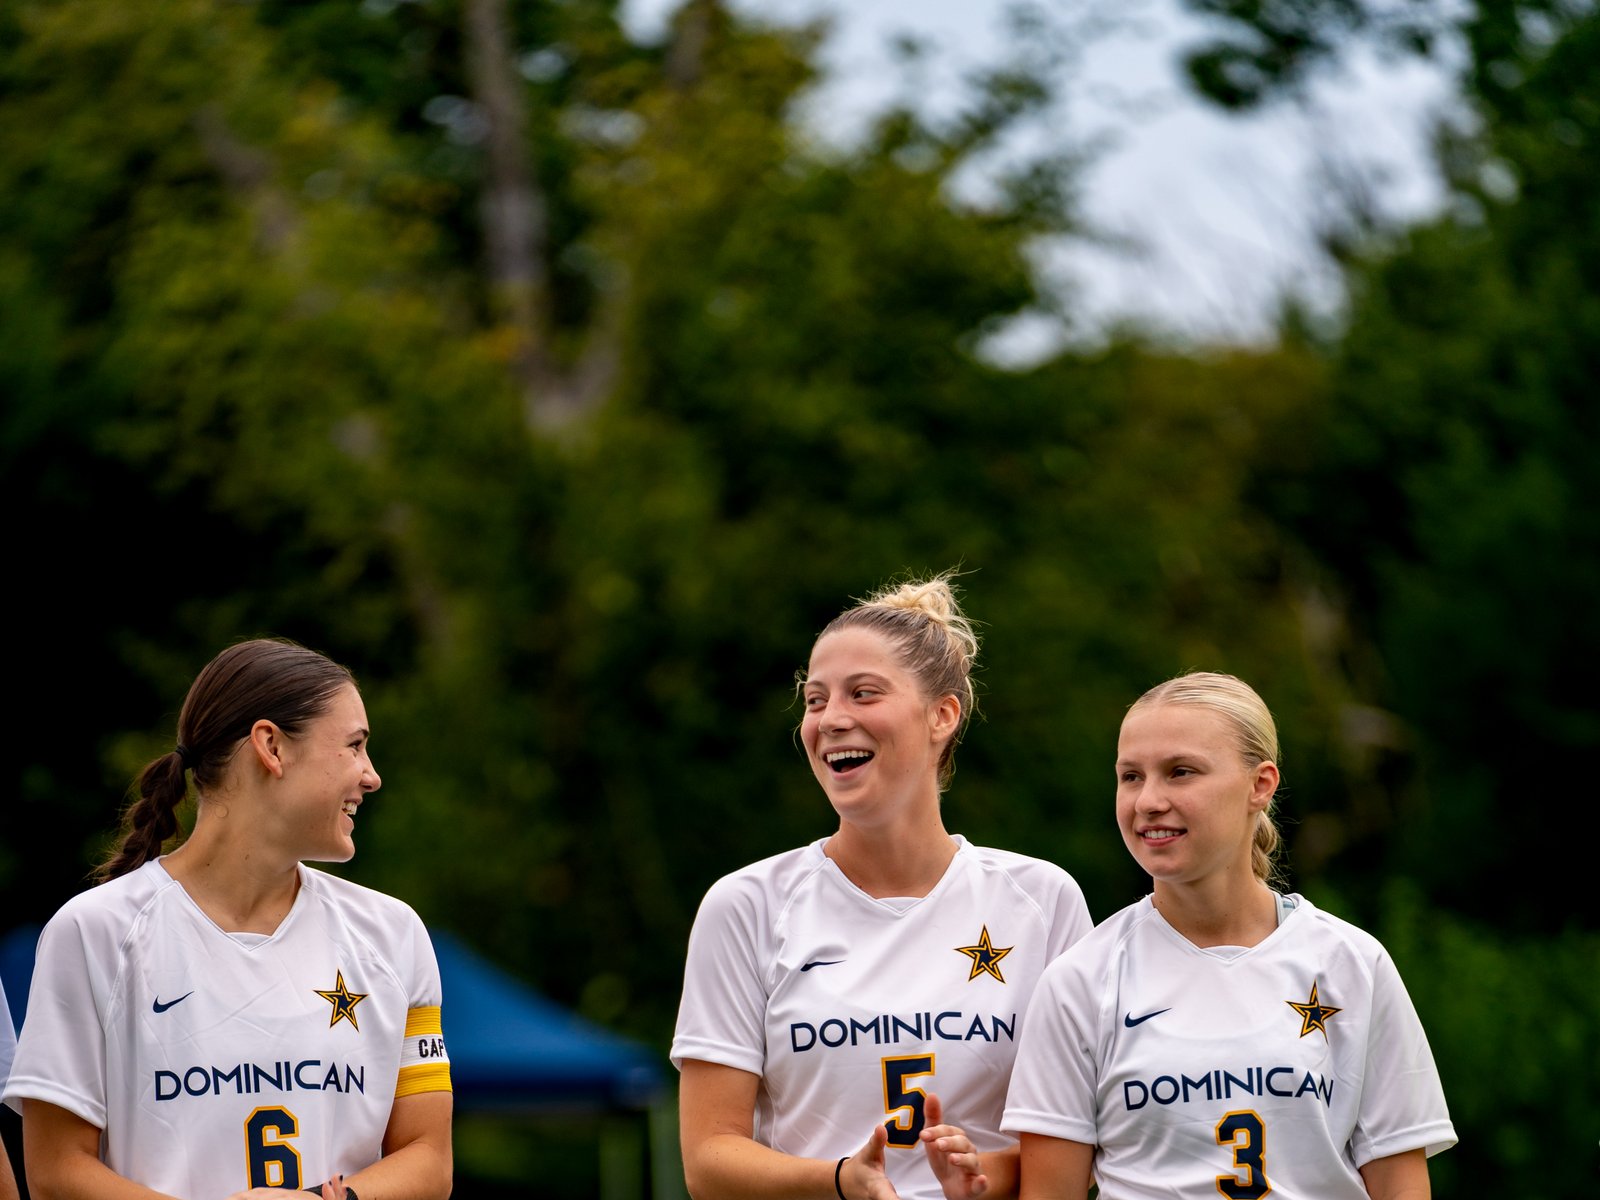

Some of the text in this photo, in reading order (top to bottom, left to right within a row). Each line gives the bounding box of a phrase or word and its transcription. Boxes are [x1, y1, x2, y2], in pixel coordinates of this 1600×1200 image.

[791, 1012, 1016, 1052] DOMINICAN
[155, 1060, 364, 1101] DOMINICAN
[881, 1053, 935, 1149] 5
[1124, 1067, 1333, 1110] DOMINICAN
[244, 1105, 303, 1190] 6
